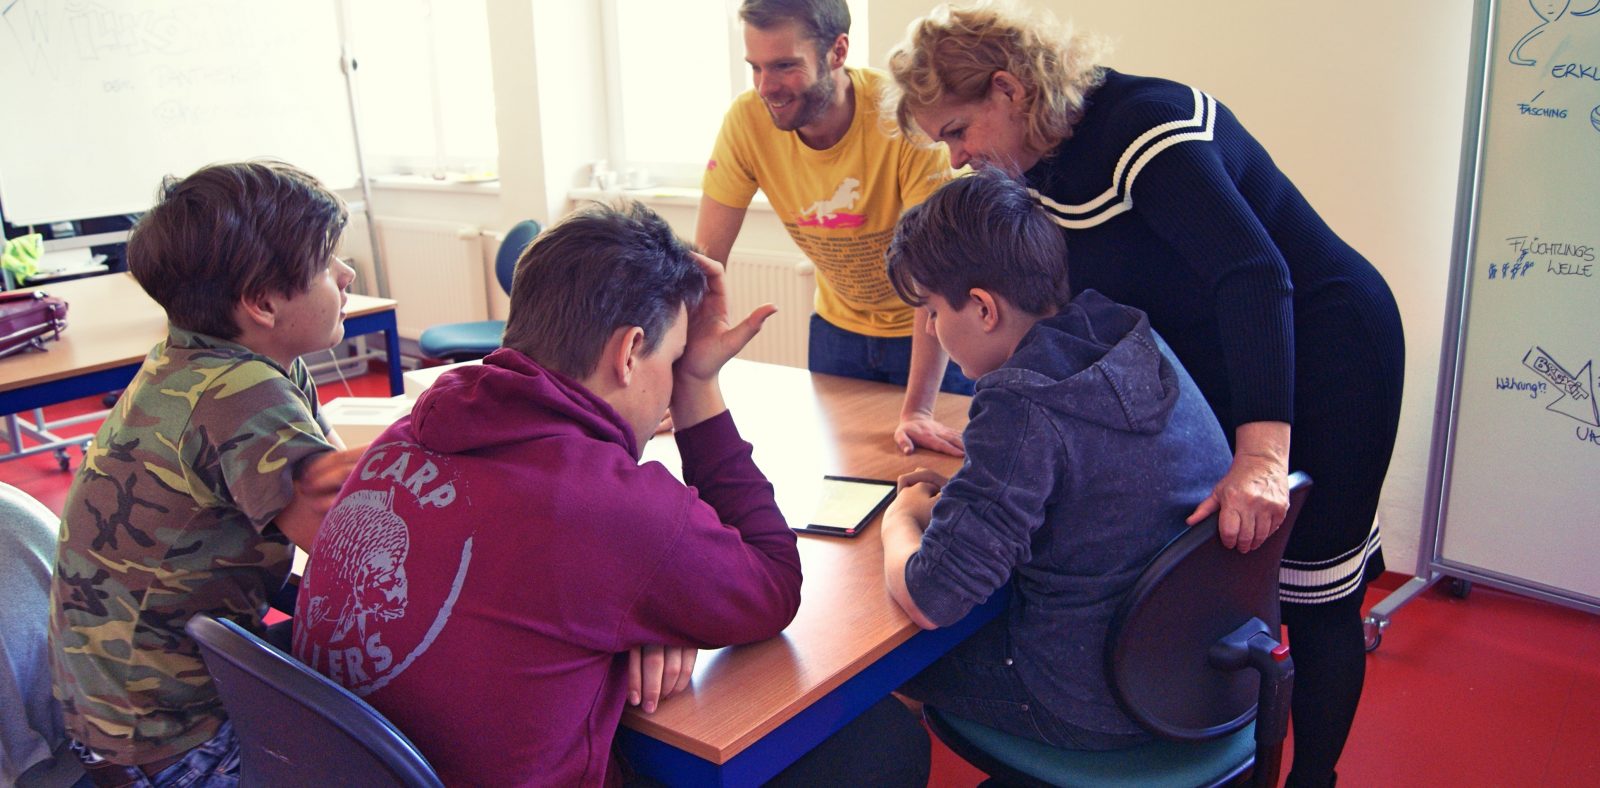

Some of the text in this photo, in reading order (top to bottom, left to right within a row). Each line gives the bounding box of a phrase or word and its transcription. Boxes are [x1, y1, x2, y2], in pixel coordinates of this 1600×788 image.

[1517, 103, 1568, 119] FASCHING
[1547, 260, 1592, 277] WELLE
[360, 451, 456, 508] CARP
